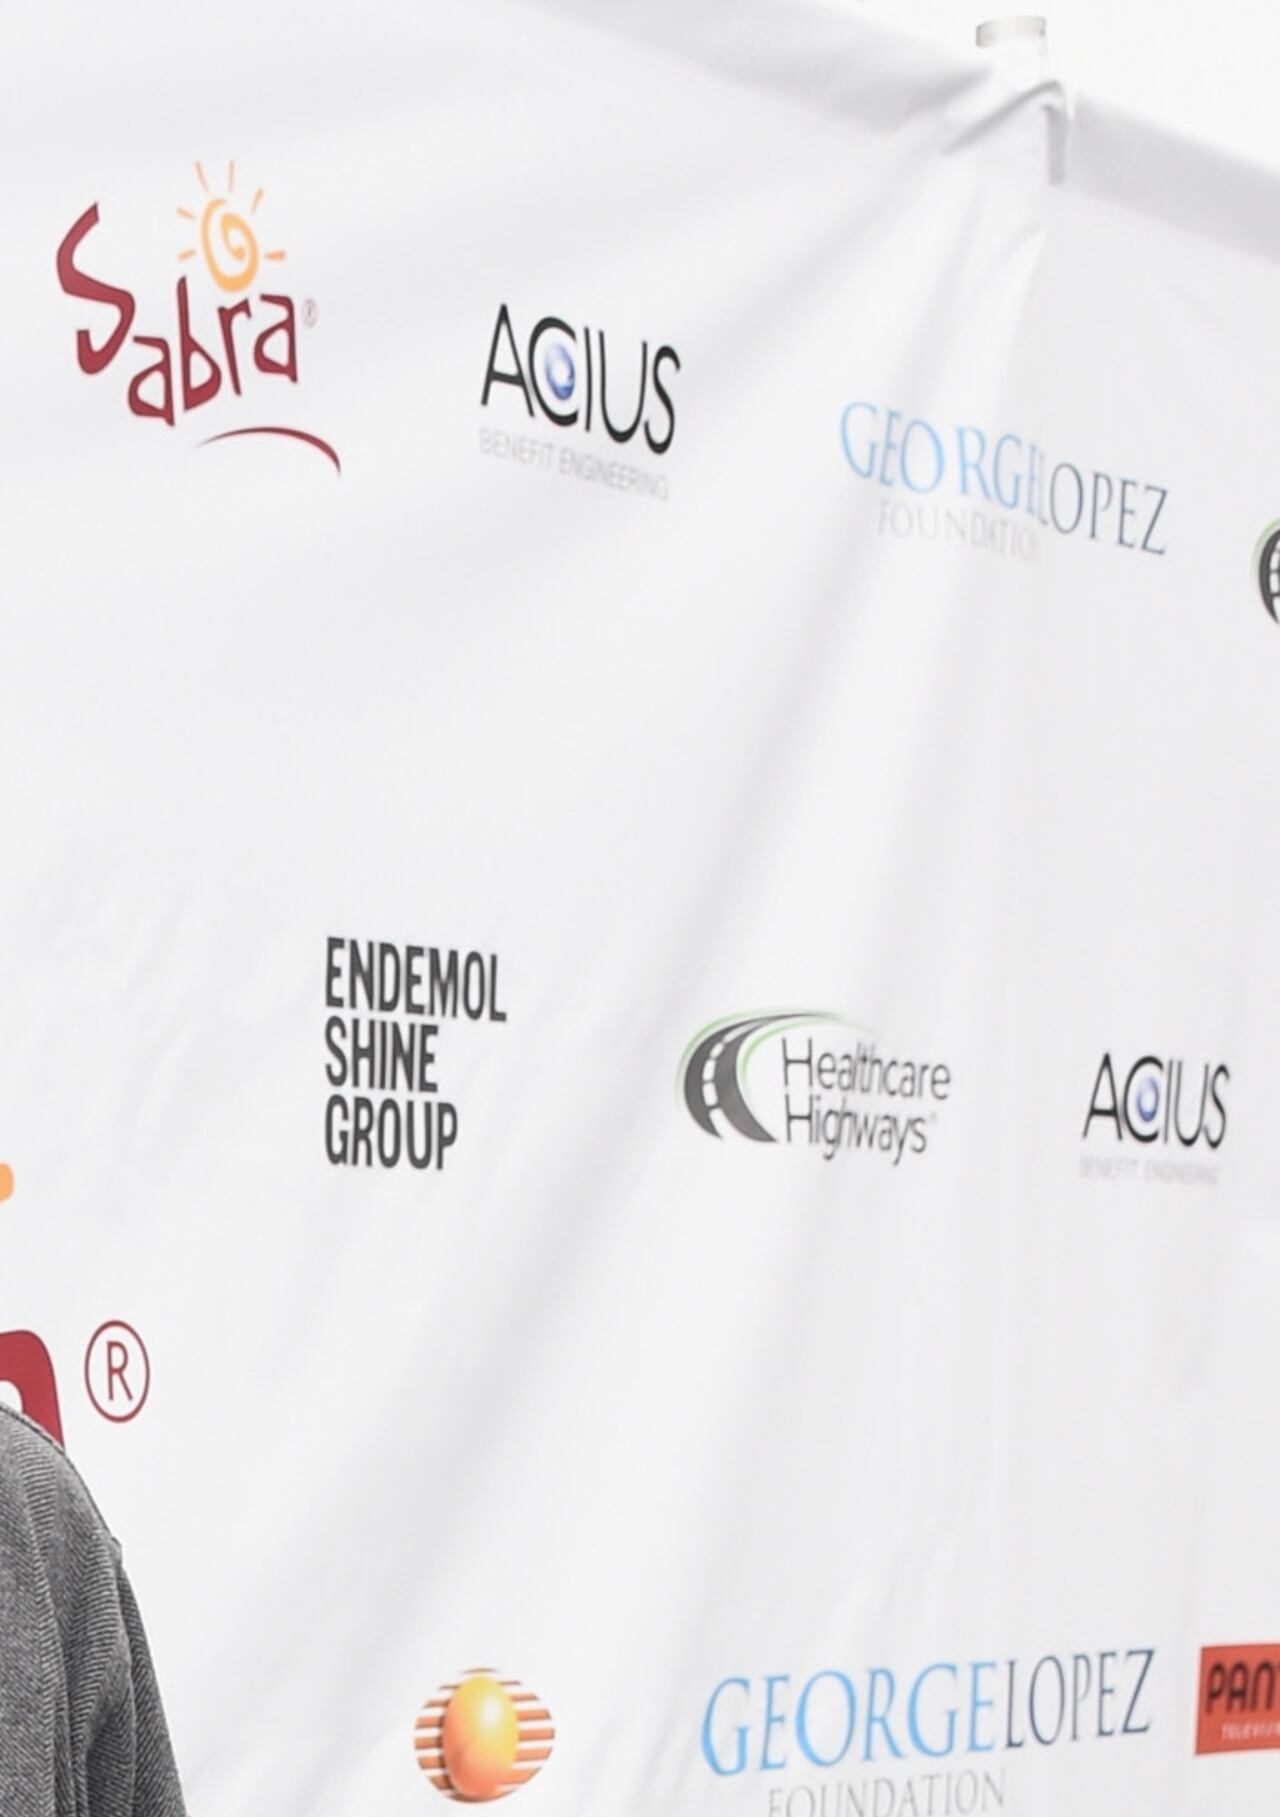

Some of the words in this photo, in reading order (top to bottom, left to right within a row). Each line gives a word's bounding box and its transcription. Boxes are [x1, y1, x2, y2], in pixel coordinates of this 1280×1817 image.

[56, 202, 298, 428] Sabra
[325, 935, 508, 1022] ENDEMOL
[324, 1015, 439, 1093] SHINE
[781, 1036, 952, 1101] Healthcare
[324, 1093, 458, 1171] GROUP
[784, 1092, 927, 1167] Highways
[1204, 1659, 1280, 1716] PAN
